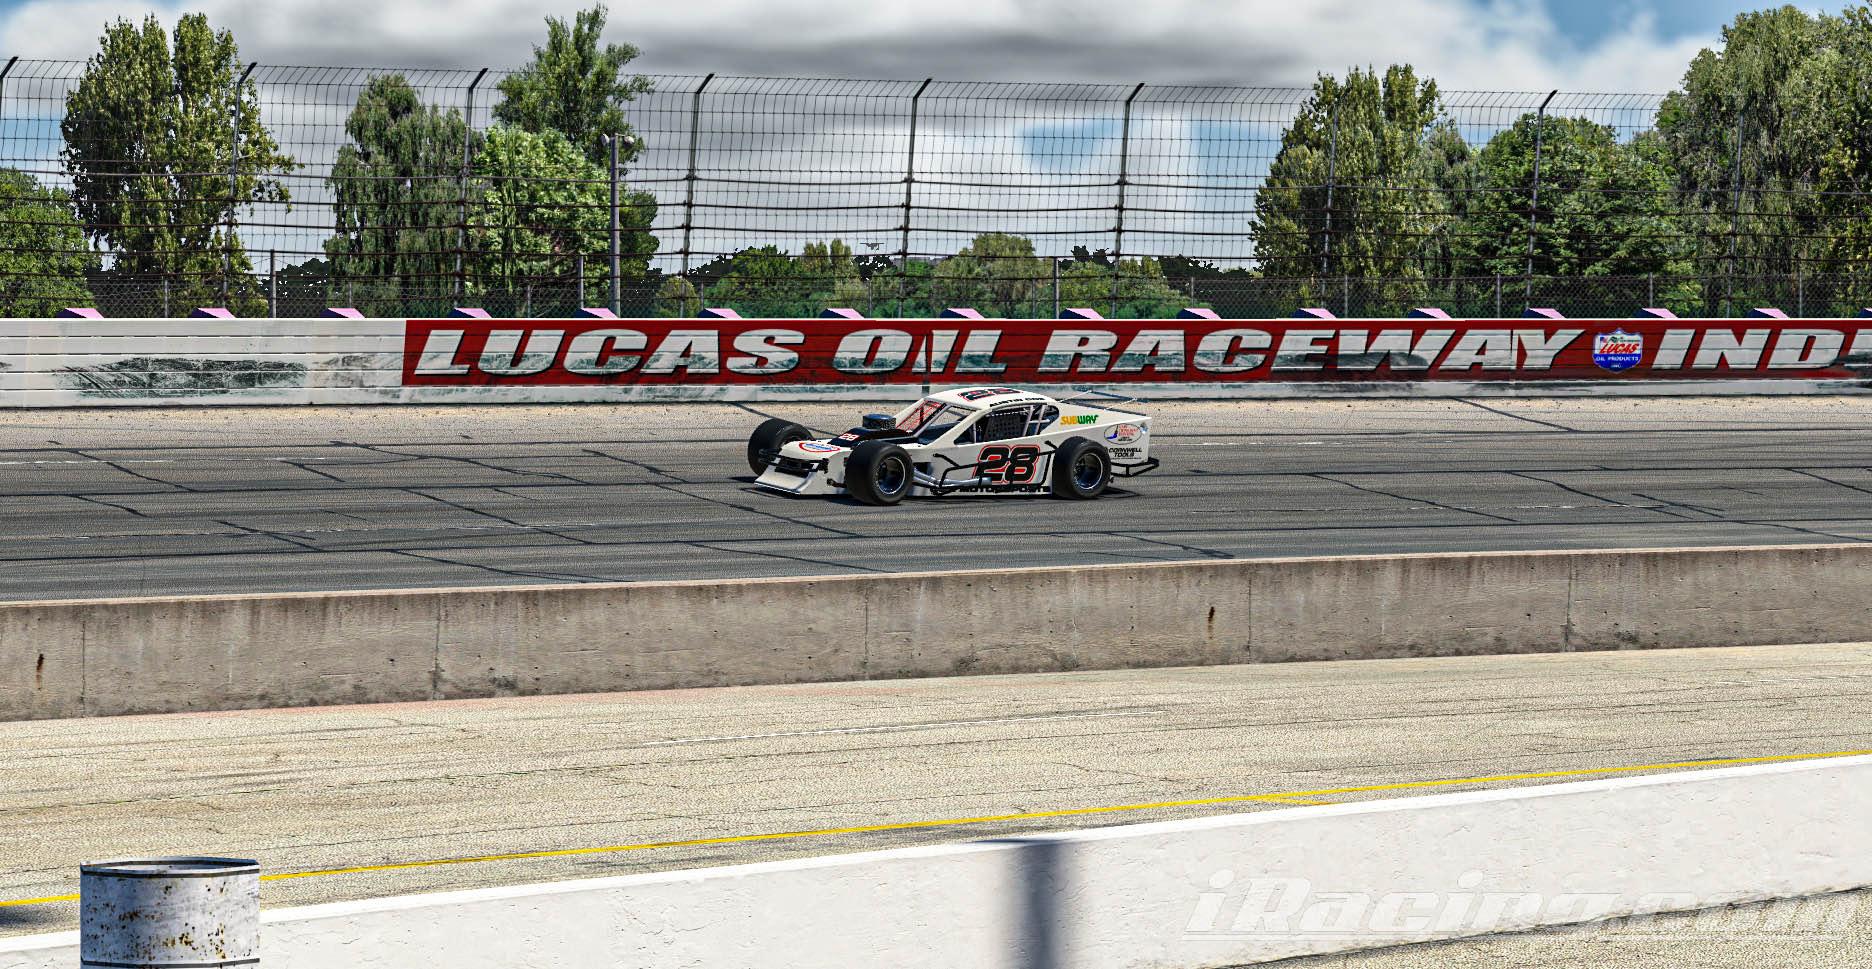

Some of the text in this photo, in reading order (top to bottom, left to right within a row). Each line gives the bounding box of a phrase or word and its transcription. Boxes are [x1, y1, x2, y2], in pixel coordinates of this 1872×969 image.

[413, 328, 806, 376] LUCAS
[832, 328, 1008, 374] OIL
[1036, 328, 1586, 374] RACEWAY
[1599, 343, 1640, 354] LUCAS
[1060, 414, 1099, 425] SUBWAY
[838, 433, 860, 441] 28
[972, 444, 1041, 485] 28
